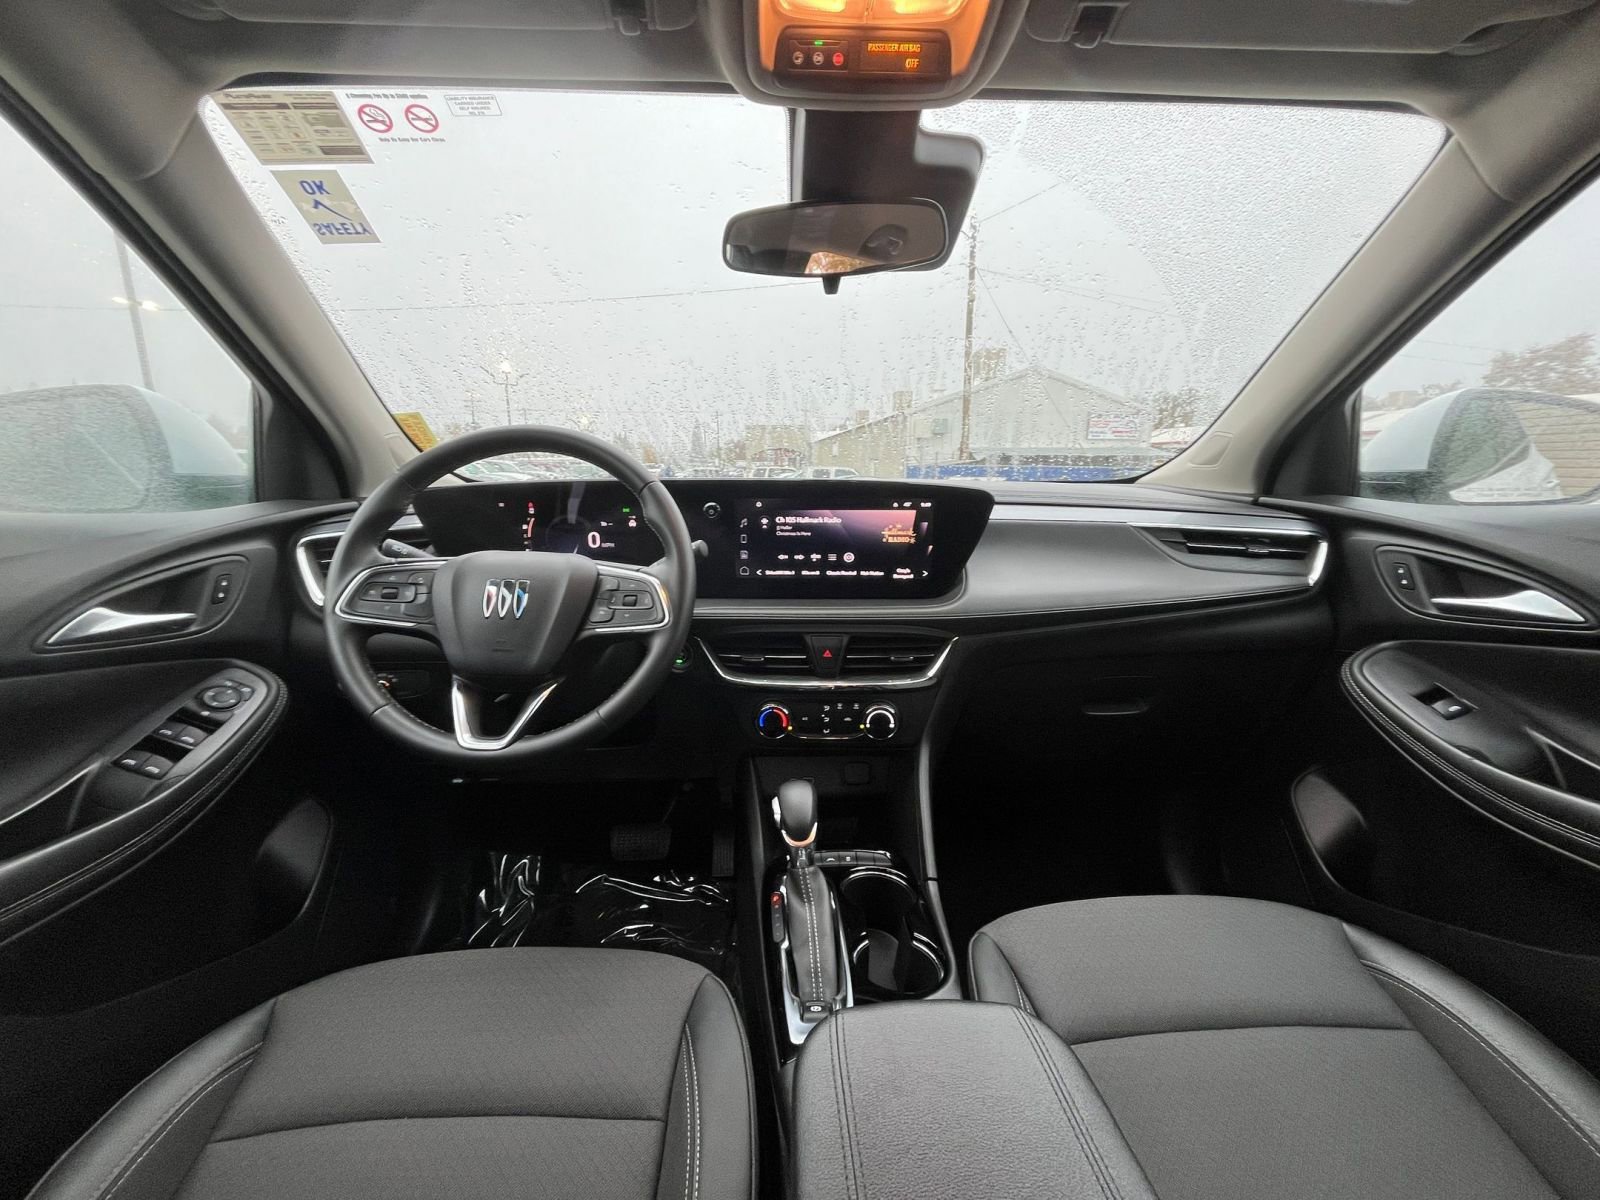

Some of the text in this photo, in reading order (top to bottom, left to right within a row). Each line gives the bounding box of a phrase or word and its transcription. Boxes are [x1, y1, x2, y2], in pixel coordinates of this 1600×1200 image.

[867, 43, 920, 53] PASSENGER AIRBAG
[905, 58, 920, 68] OFF
[775, 516, 842, 524] Ch 105 Hallmark Radio
[587, 531, 601, 549] 0
